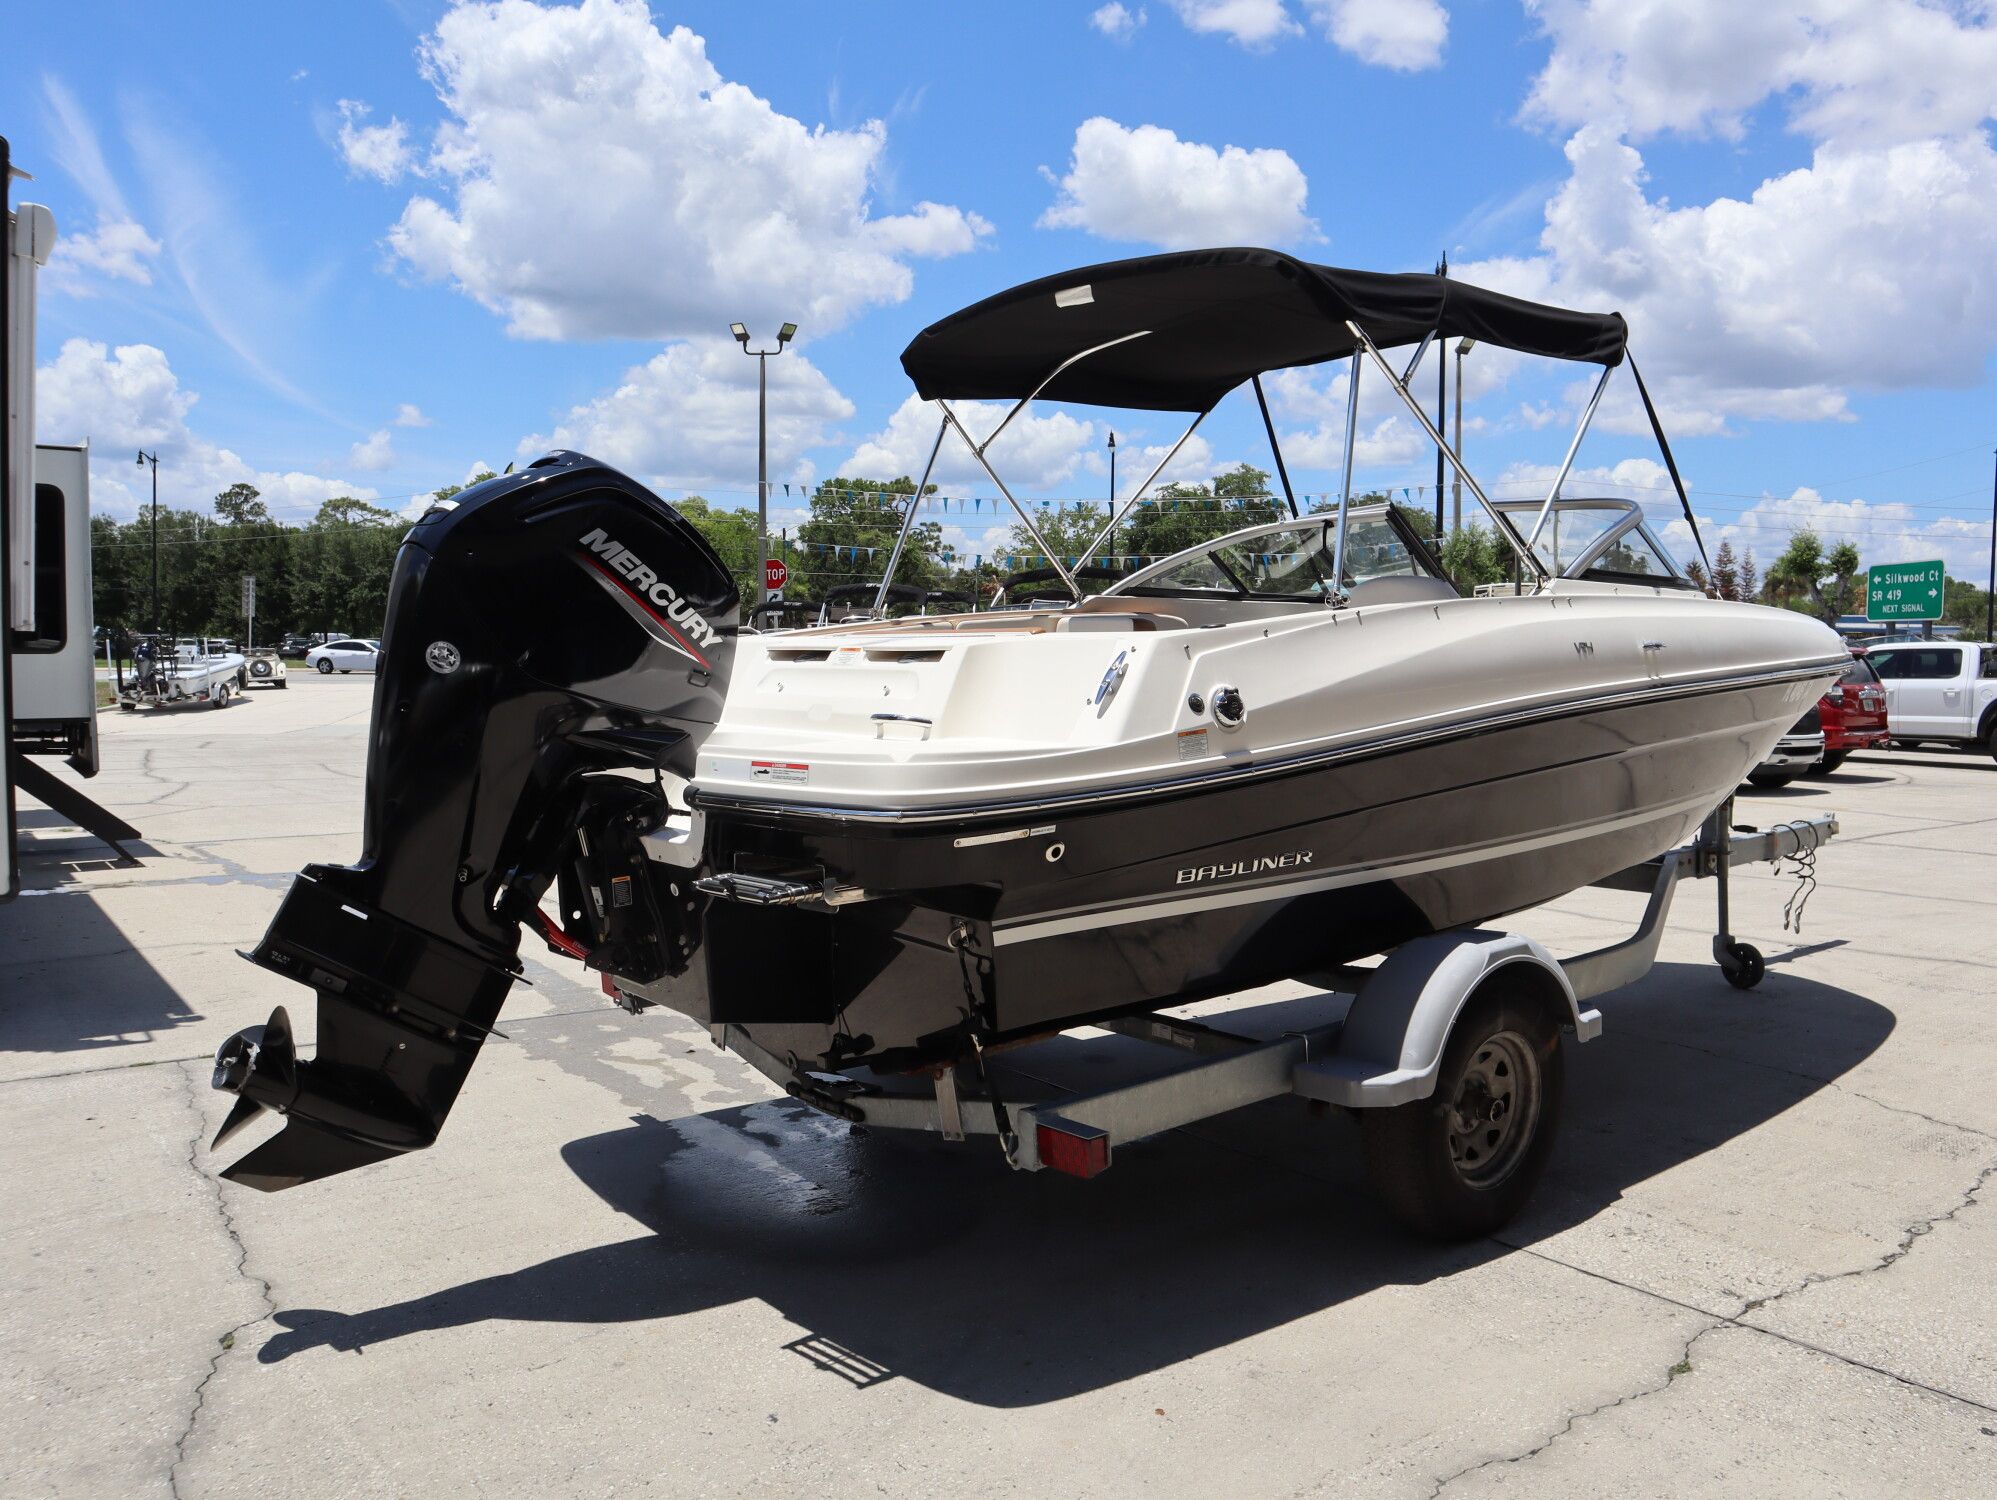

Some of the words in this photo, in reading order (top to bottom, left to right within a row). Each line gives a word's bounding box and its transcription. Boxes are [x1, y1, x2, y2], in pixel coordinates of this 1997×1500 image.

[766, 568, 785, 580] TOP
[1885, 571, 1925, 584] Silkwood
[1929, 570, 1939, 581] Ct
[579, 528, 723, 648] MERCURY
[1872, 591, 1883, 601] SR
[1886, 589, 1902, 601] 419
[1882, 604, 1899, 614] NEXT
[1901, 603, 1925, 613] SIGNAL
[1176, 849, 1313, 885] BAYLINER
